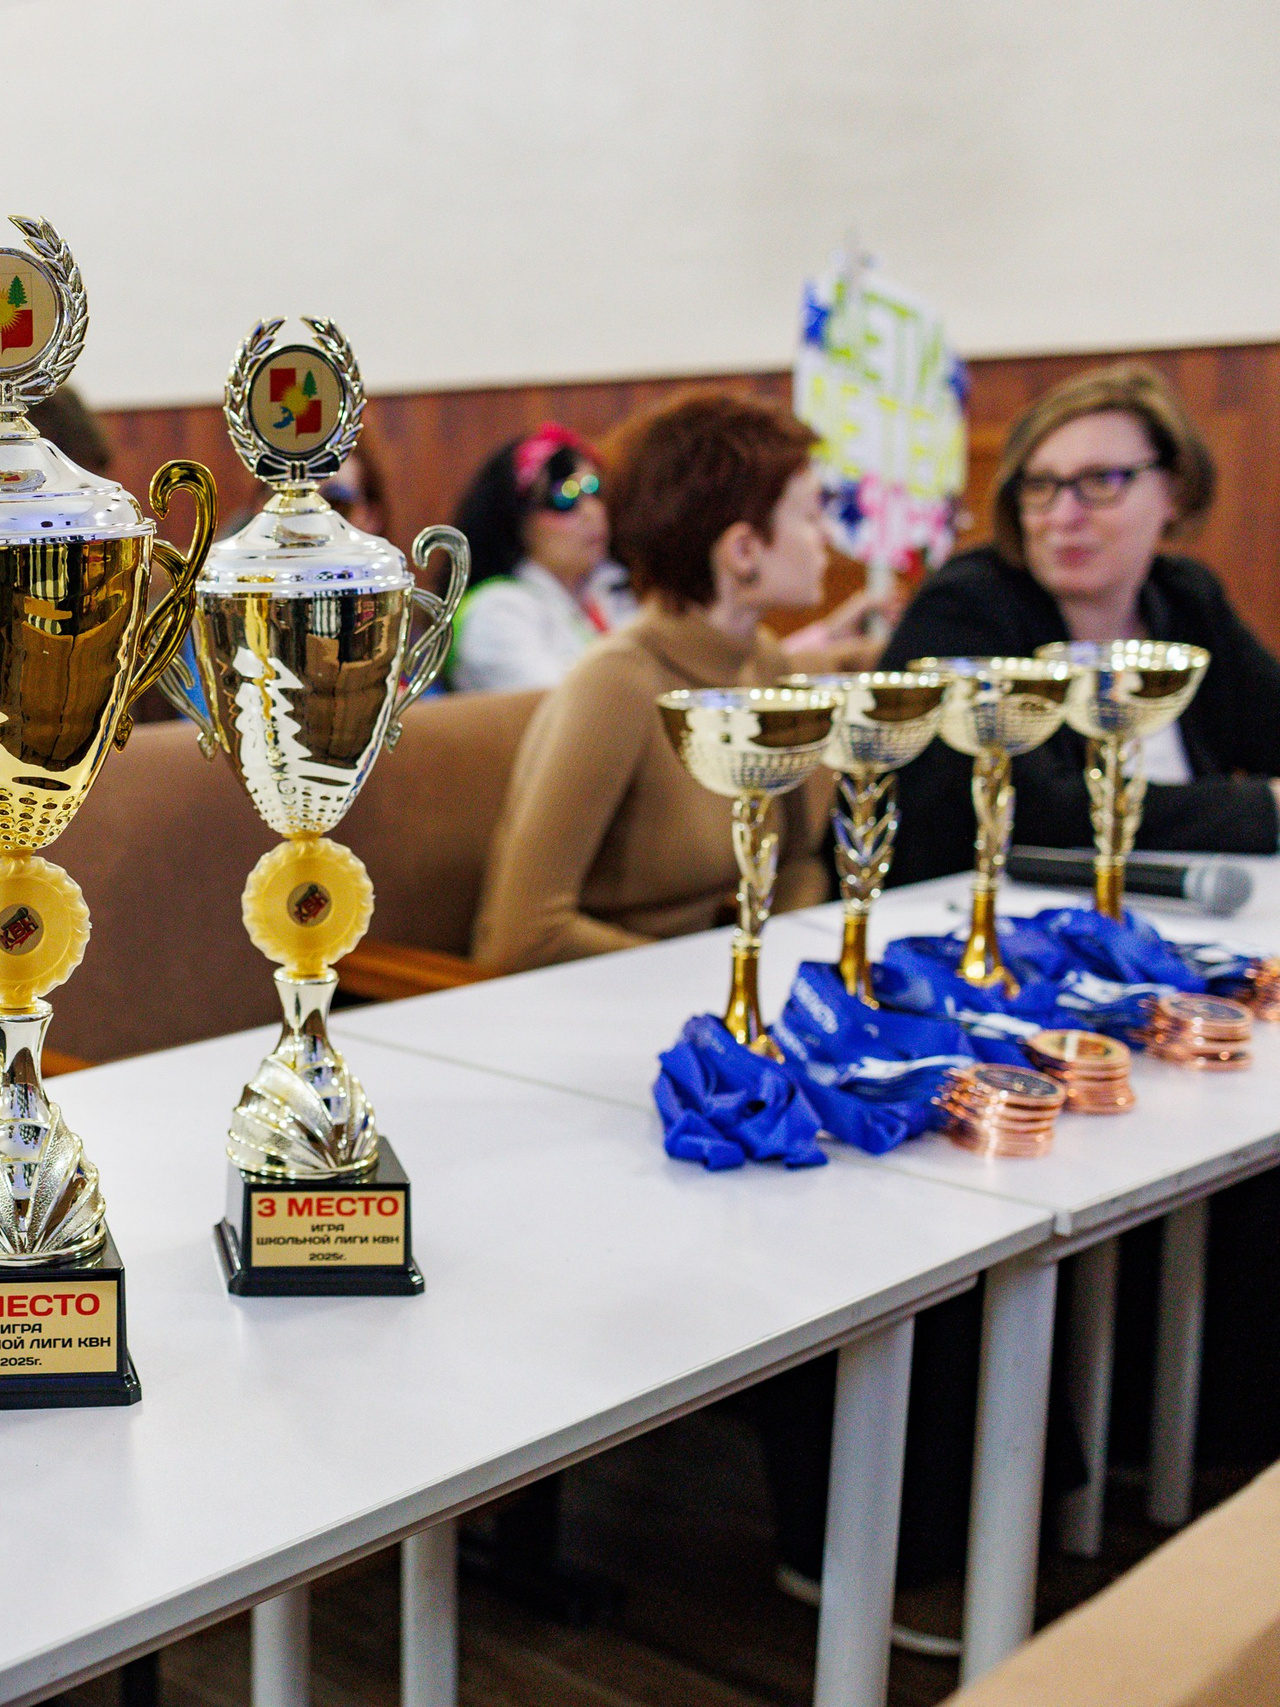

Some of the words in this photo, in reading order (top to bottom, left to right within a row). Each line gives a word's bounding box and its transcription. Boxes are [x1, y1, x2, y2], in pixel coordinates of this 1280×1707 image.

[256, 1198, 277, 1218] 3
[287, 1196, 400, 1217] МЕСТО
[311, 1223, 345, 1233] ИГРА
[256, 1234, 330, 1246] ШКОЛЬНОЙ
[334, 1235, 369, 1245] ЛИГИ
[373, 1235, 400, 1245] КВН
[0, 1323, 42, 1334] ИГРА
[29, 1337, 73, 1349] ЛИГИ
[78, 1337, 111, 1348] КВН
[0, 1357, 42, 1367] 2025г.
